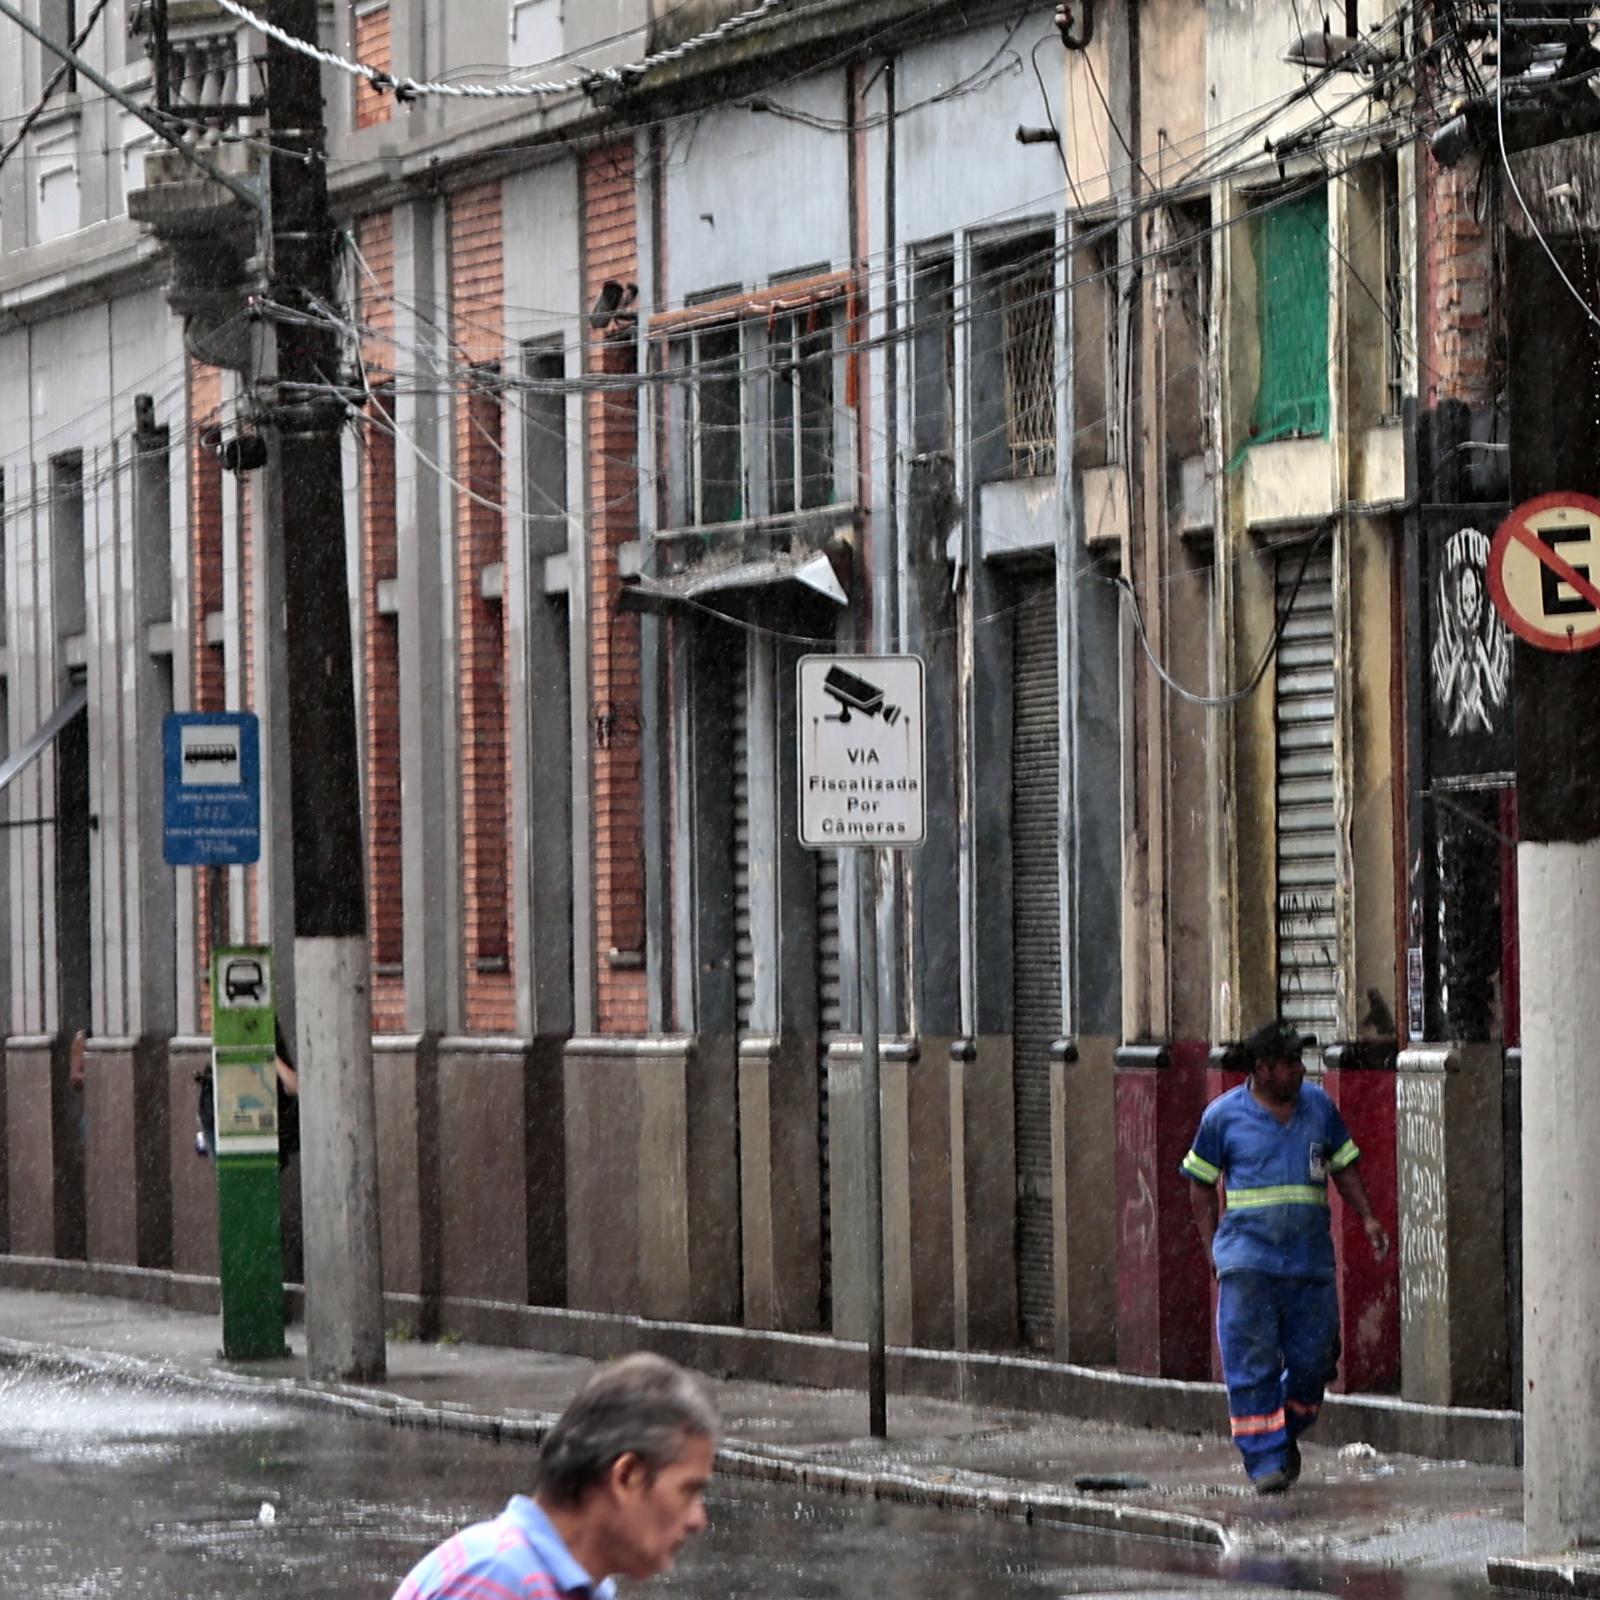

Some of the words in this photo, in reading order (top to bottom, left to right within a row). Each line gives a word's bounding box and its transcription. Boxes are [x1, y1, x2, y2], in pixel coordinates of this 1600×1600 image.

[1537, 524, 1598, 616] E
[847, 747, 879, 765] VIA
[809, 775, 918, 792] Fiscalizada
[847, 797, 880, 813] Por
[822, 817, 906, 834] Câmeras
